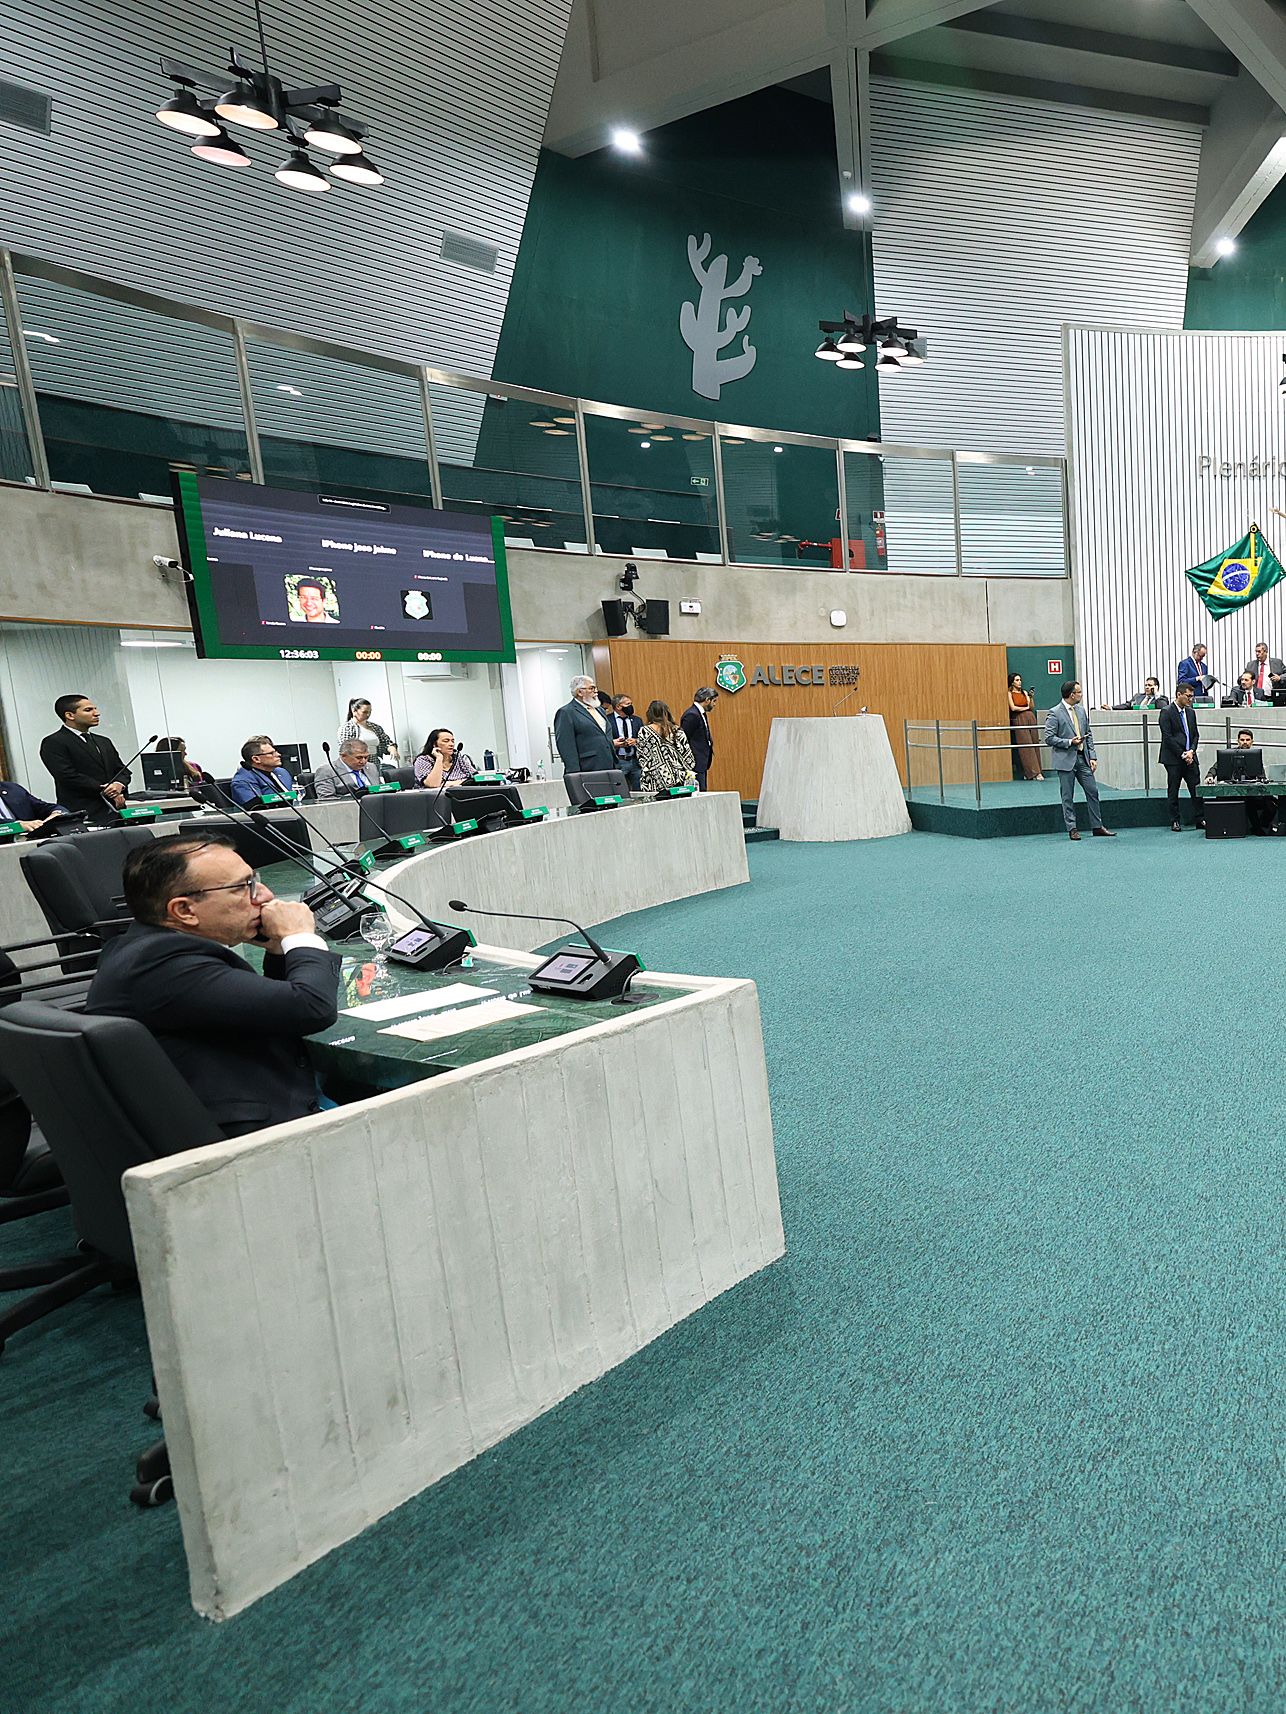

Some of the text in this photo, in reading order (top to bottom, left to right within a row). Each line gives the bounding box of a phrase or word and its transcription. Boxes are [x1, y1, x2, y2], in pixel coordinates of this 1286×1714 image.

[279, 650, 320, 659] 12:36:03
[355, 651, 382, 660] 00:00
[417, 652, 443, 661] 00:00
[1050, 662, 1060, 671] H
[750, 664, 826, 686] ALECE
